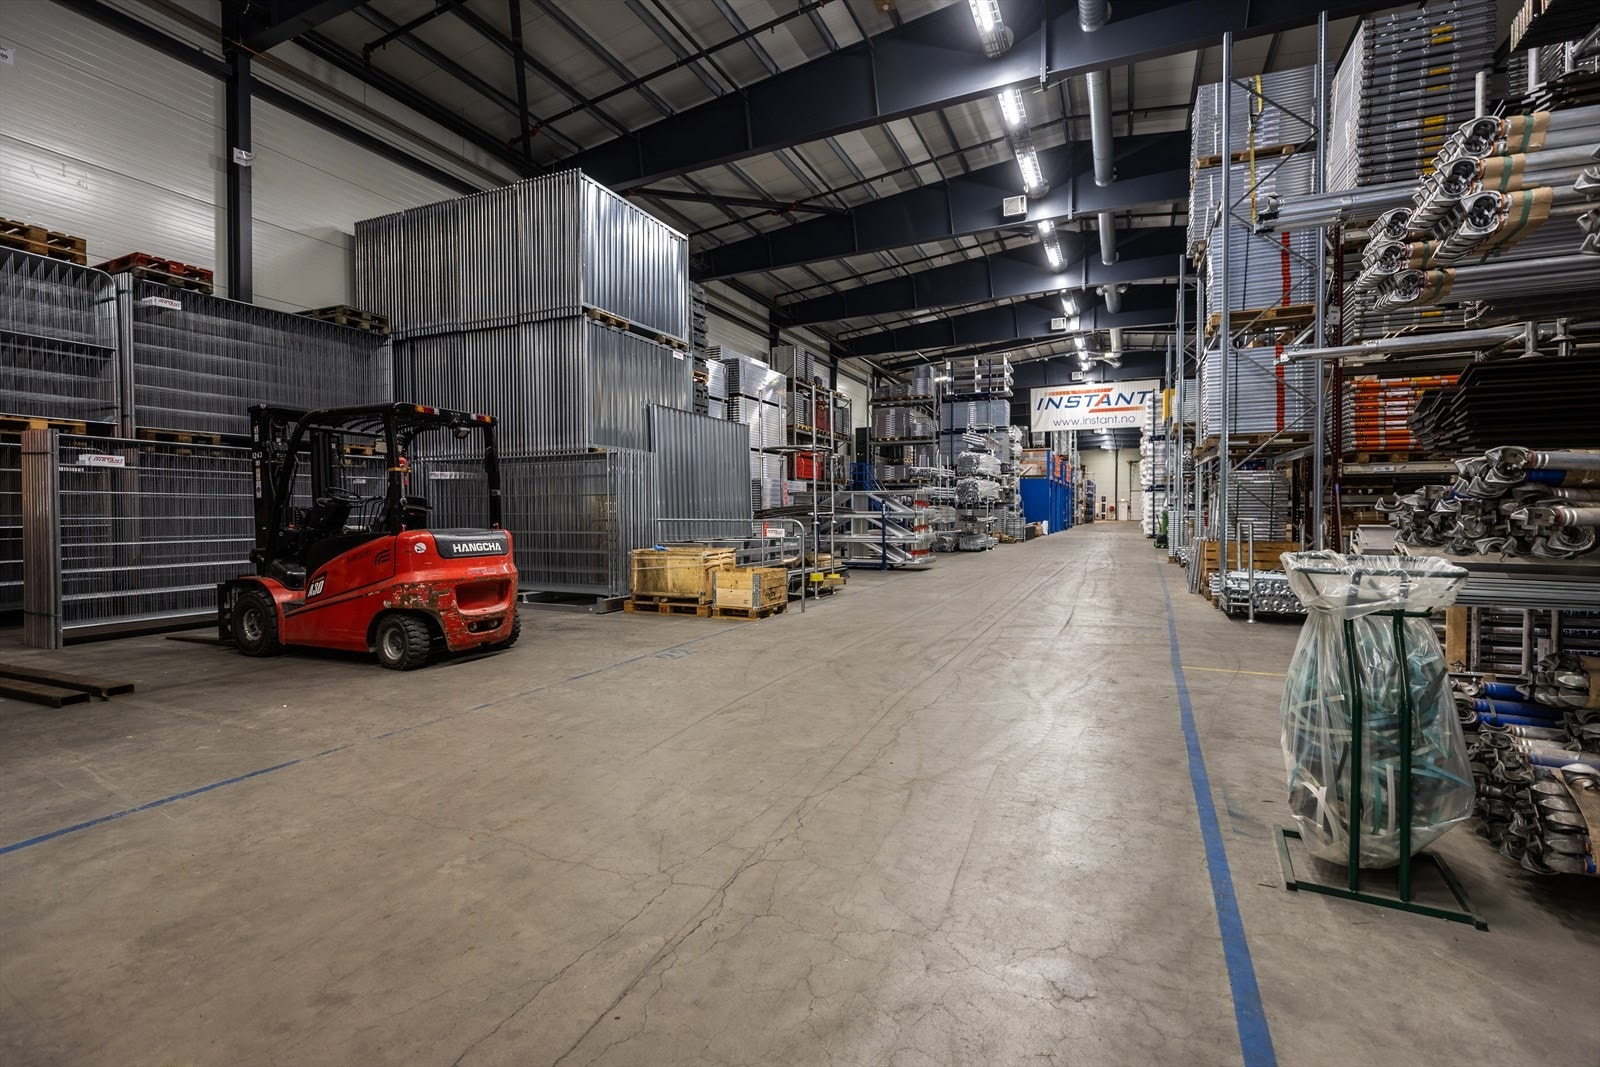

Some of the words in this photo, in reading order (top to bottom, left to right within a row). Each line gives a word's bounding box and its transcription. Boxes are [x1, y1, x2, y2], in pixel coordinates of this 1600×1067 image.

[1037, 391, 1152, 410] INSTANT
[1053, 415, 1135, 427] www.instant.no
[452, 542, 502, 553] HANGCHA
[307, 580, 325, 598] A30
